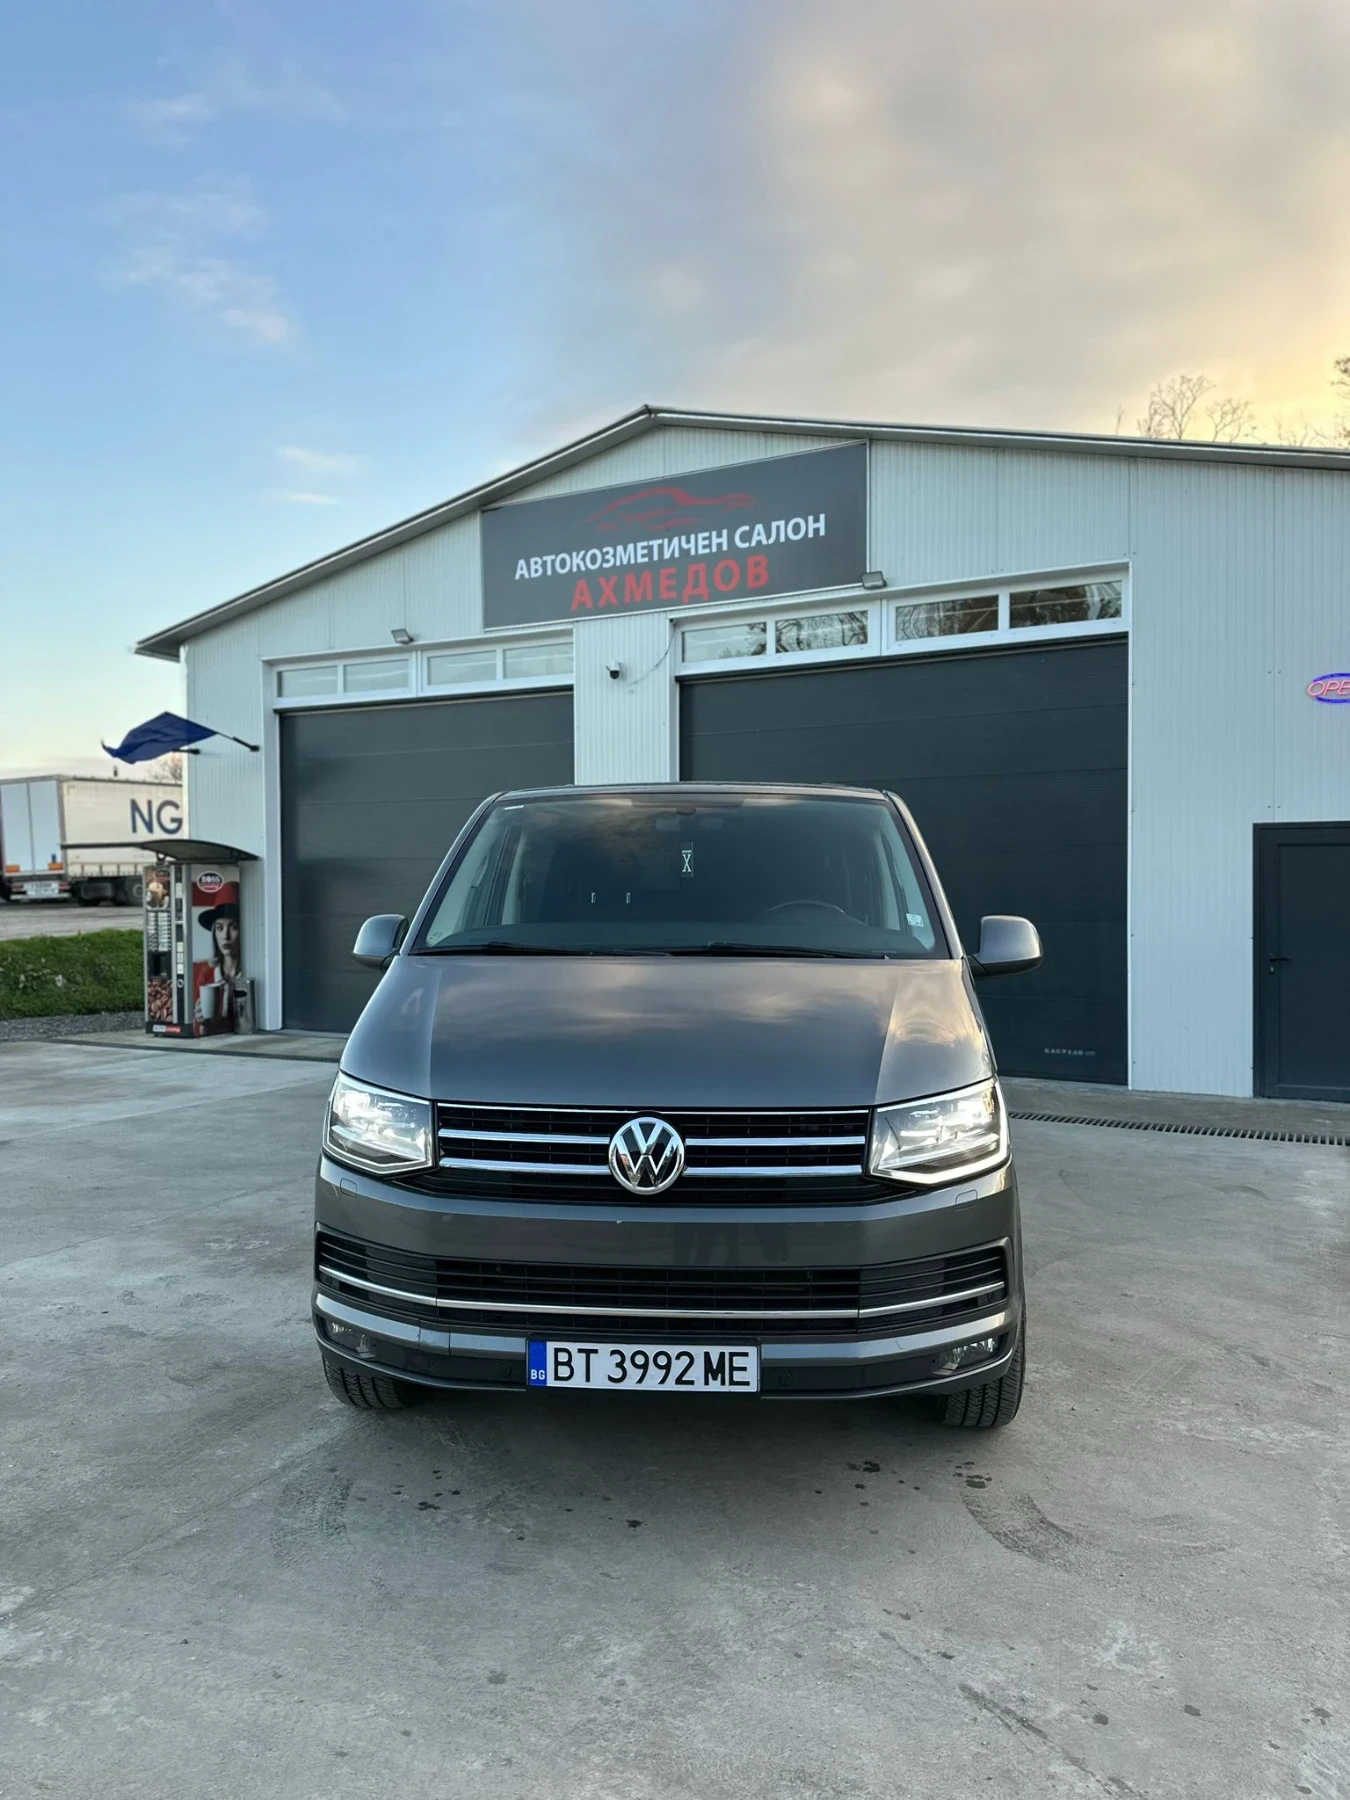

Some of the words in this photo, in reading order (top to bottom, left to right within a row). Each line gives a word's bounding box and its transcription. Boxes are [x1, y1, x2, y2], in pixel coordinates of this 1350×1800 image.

[515, 529, 728, 580] АВТОКОЗМЕТИЧЕН
[734, 513, 826, 549] САЛОН
[571, 554, 769, 611] АХМЕДОВ
[130, 799, 183, 834] NG
[530, 1368, 546, 1380] BG
[553, 1347, 599, 1383] BT
[607, 1349, 695, 1386] 3992
[703, 1351, 751, 1387] ME
